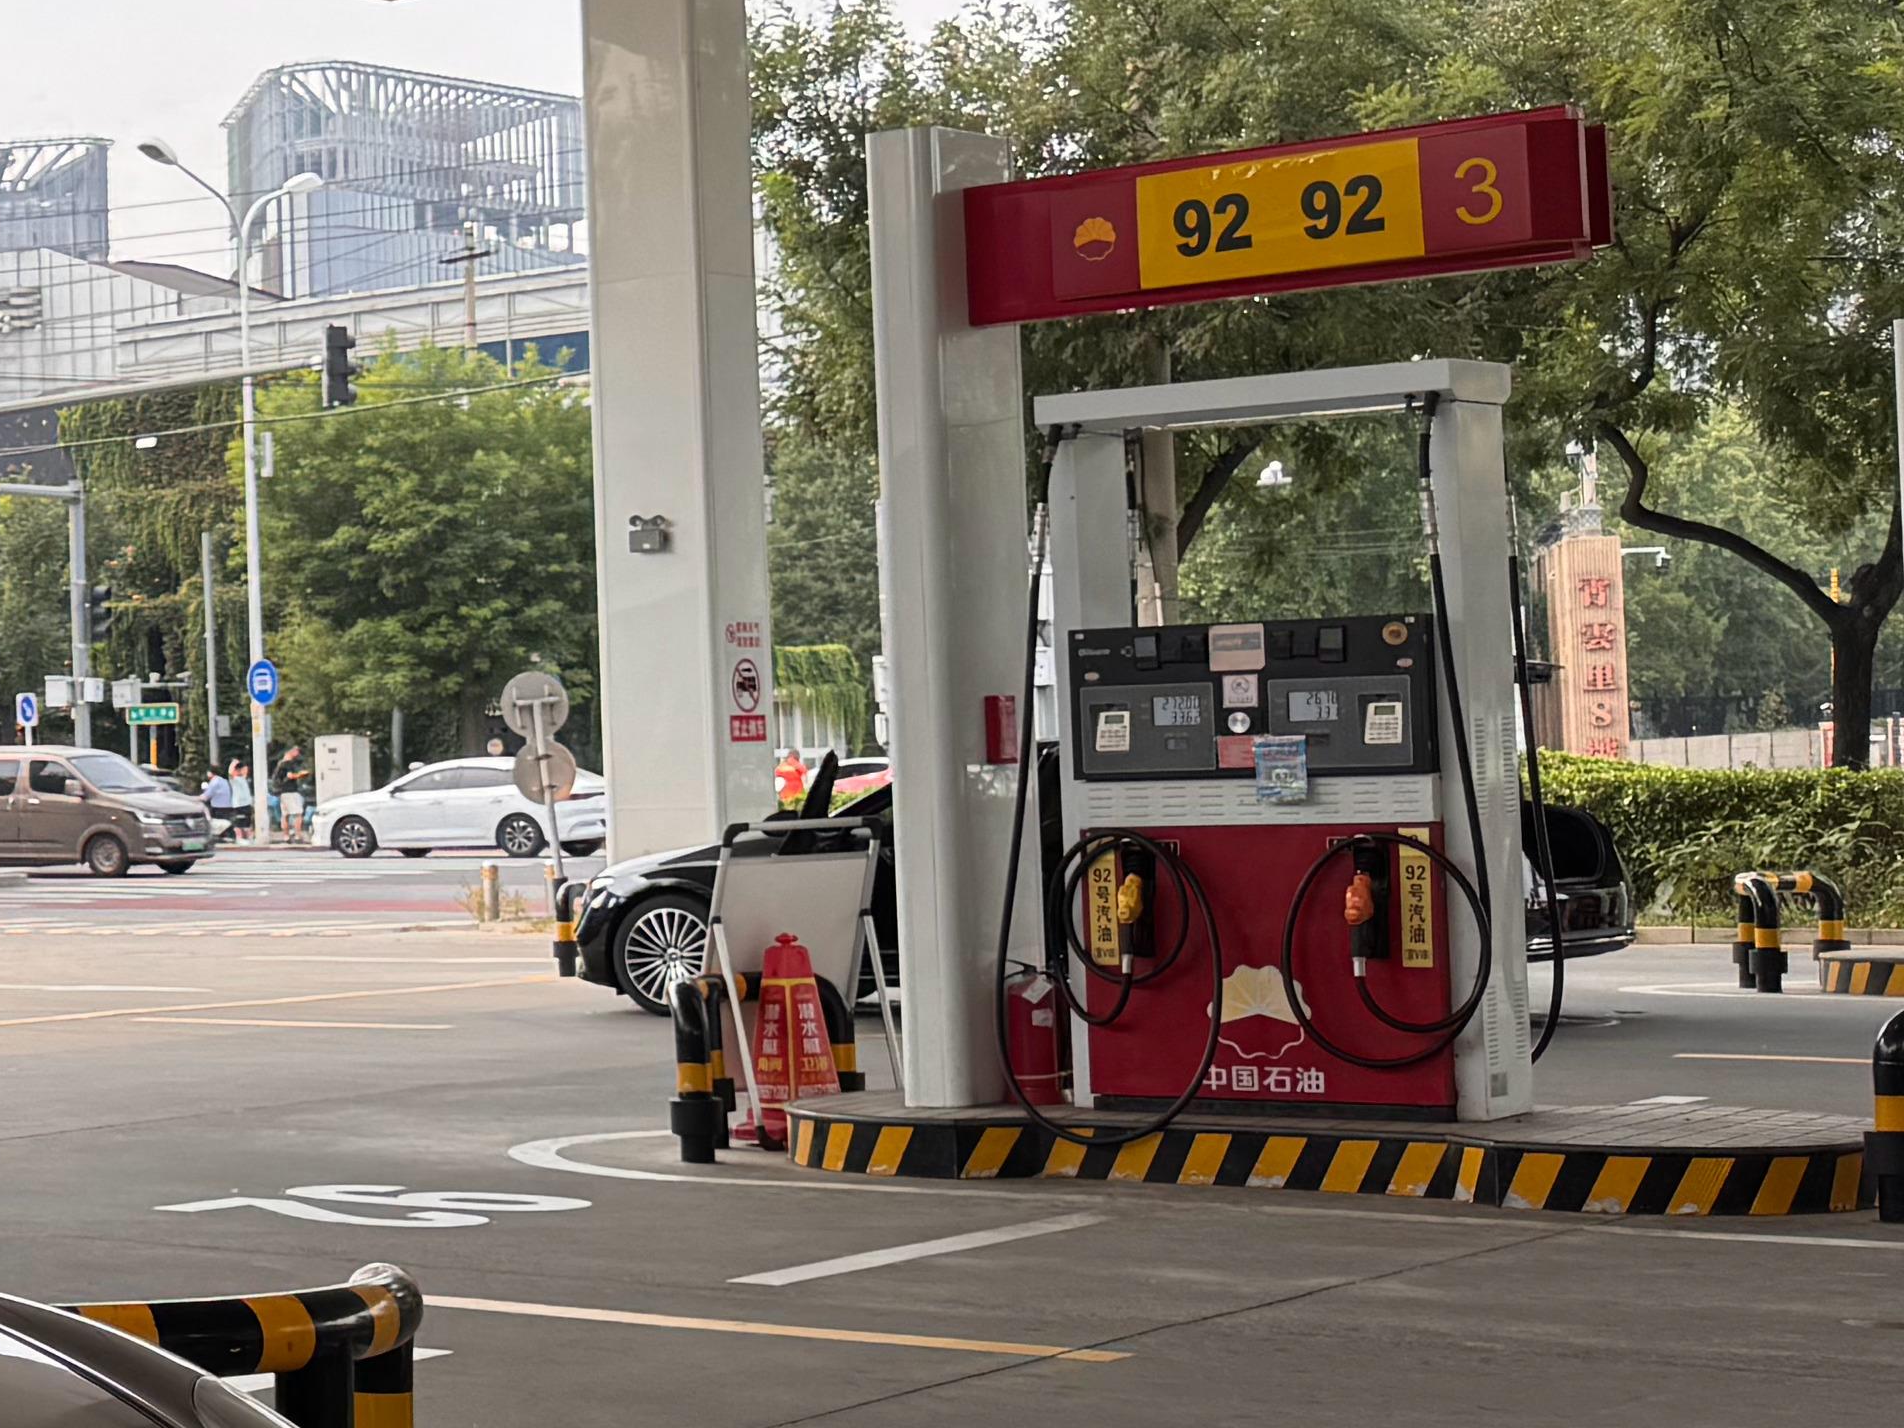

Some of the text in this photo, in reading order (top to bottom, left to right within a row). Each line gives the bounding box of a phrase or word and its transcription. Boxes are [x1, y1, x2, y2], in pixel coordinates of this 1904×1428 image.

[1173, 174, 1385, 257] 92 92
[1454, 157, 1503, 226] 3
[1202, 1065, 1325, 1095] 中国石油
